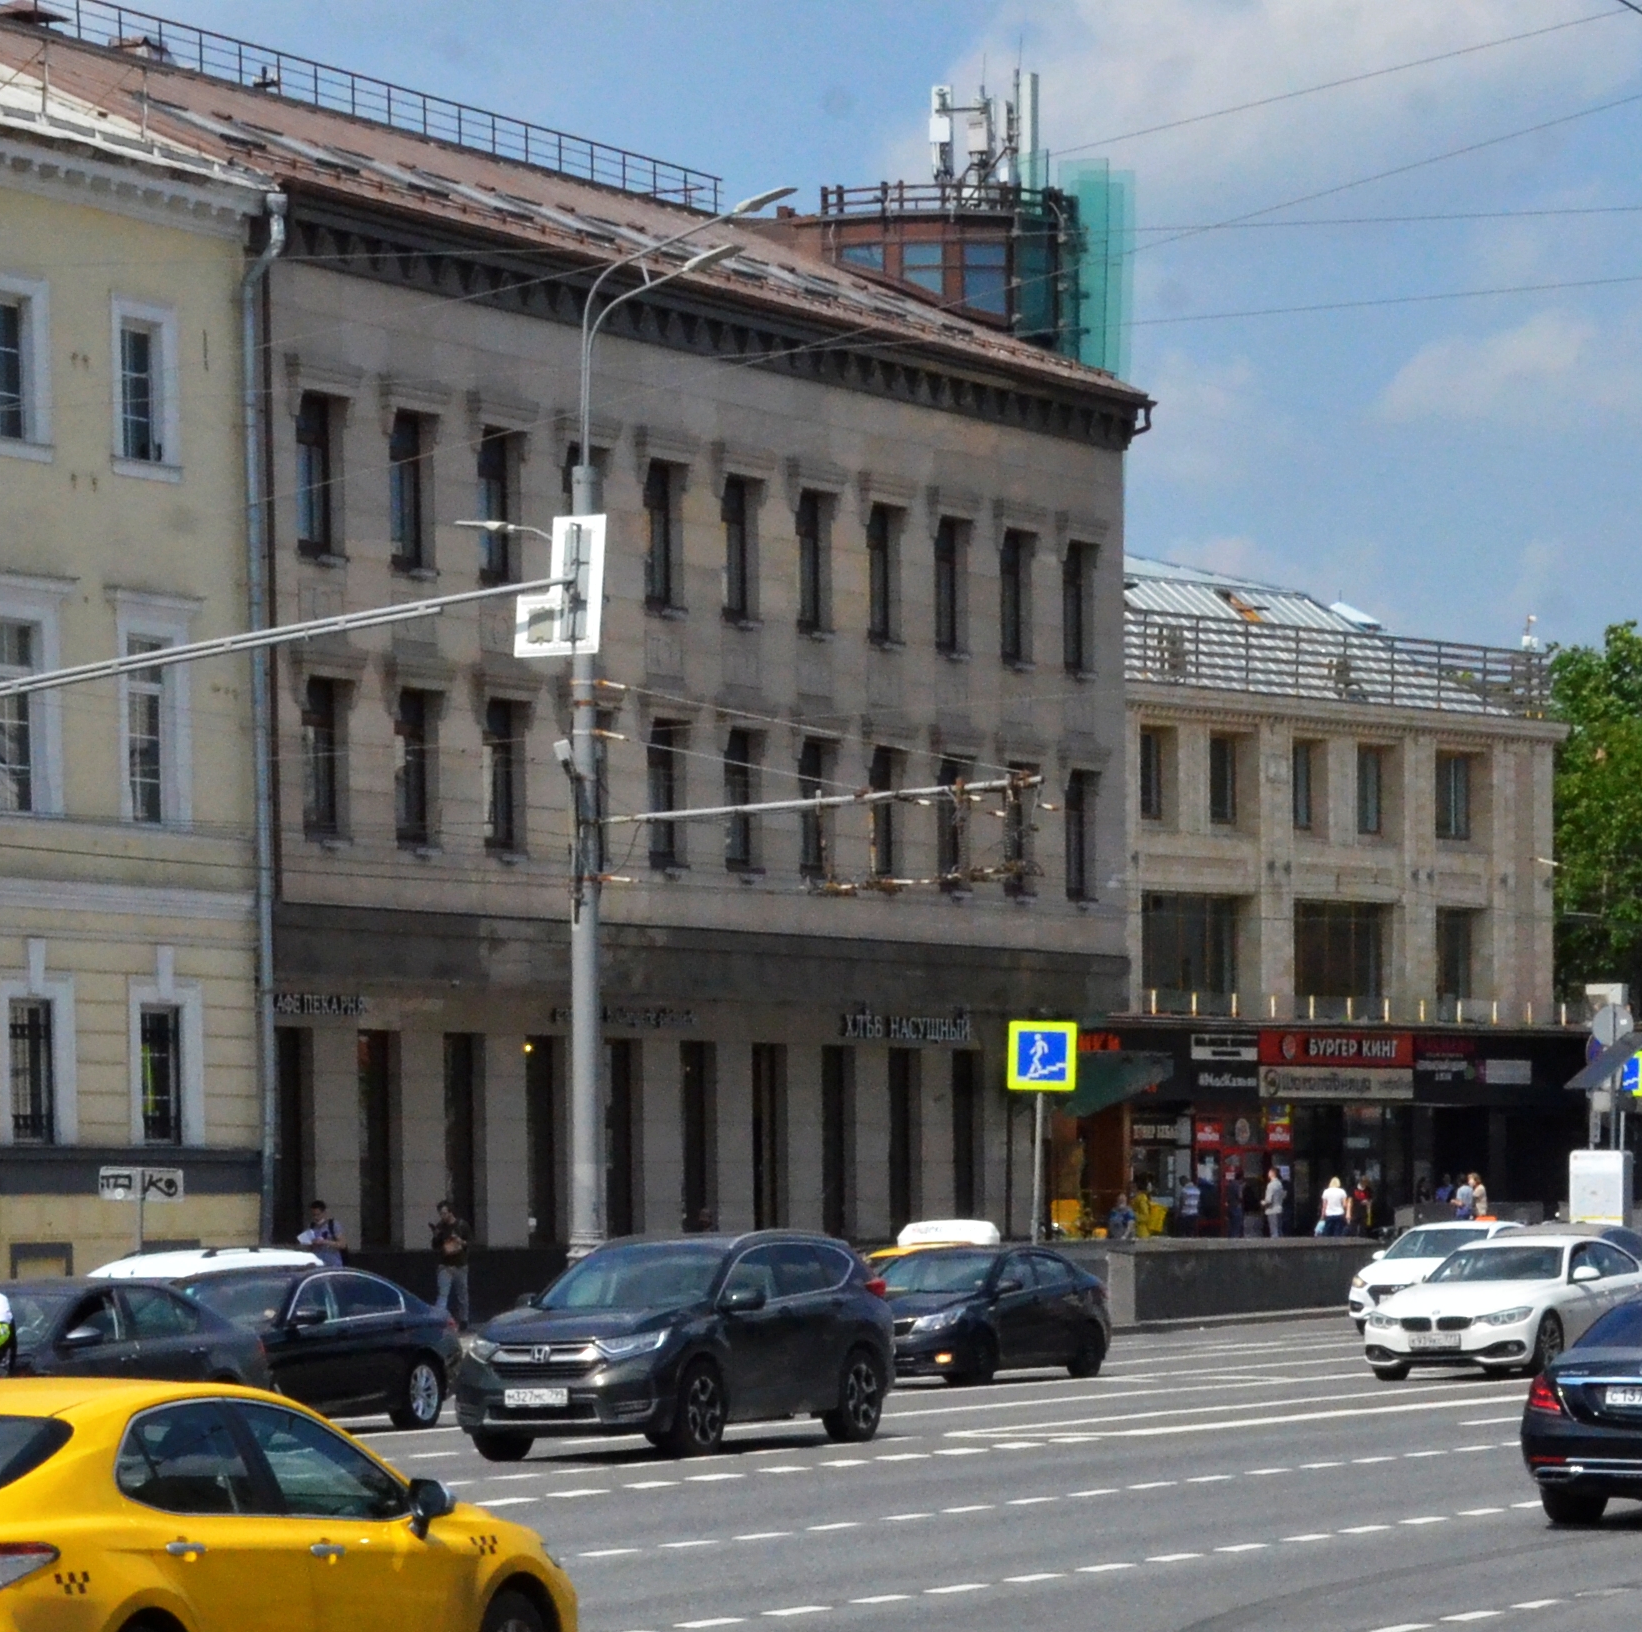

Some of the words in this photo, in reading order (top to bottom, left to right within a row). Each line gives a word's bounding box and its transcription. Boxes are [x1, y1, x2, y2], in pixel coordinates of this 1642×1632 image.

[275, 994, 301, 1015] АФЕ
[303, 994, 367, 1016] ПЕКАРНЯ
[889, 1008, 972, 1042] НАСУЩНЫЙ
[1309, 1038, 1357, 1057] БУРГЕР
[1362, 1039, 1398, 1058] КИНГ
